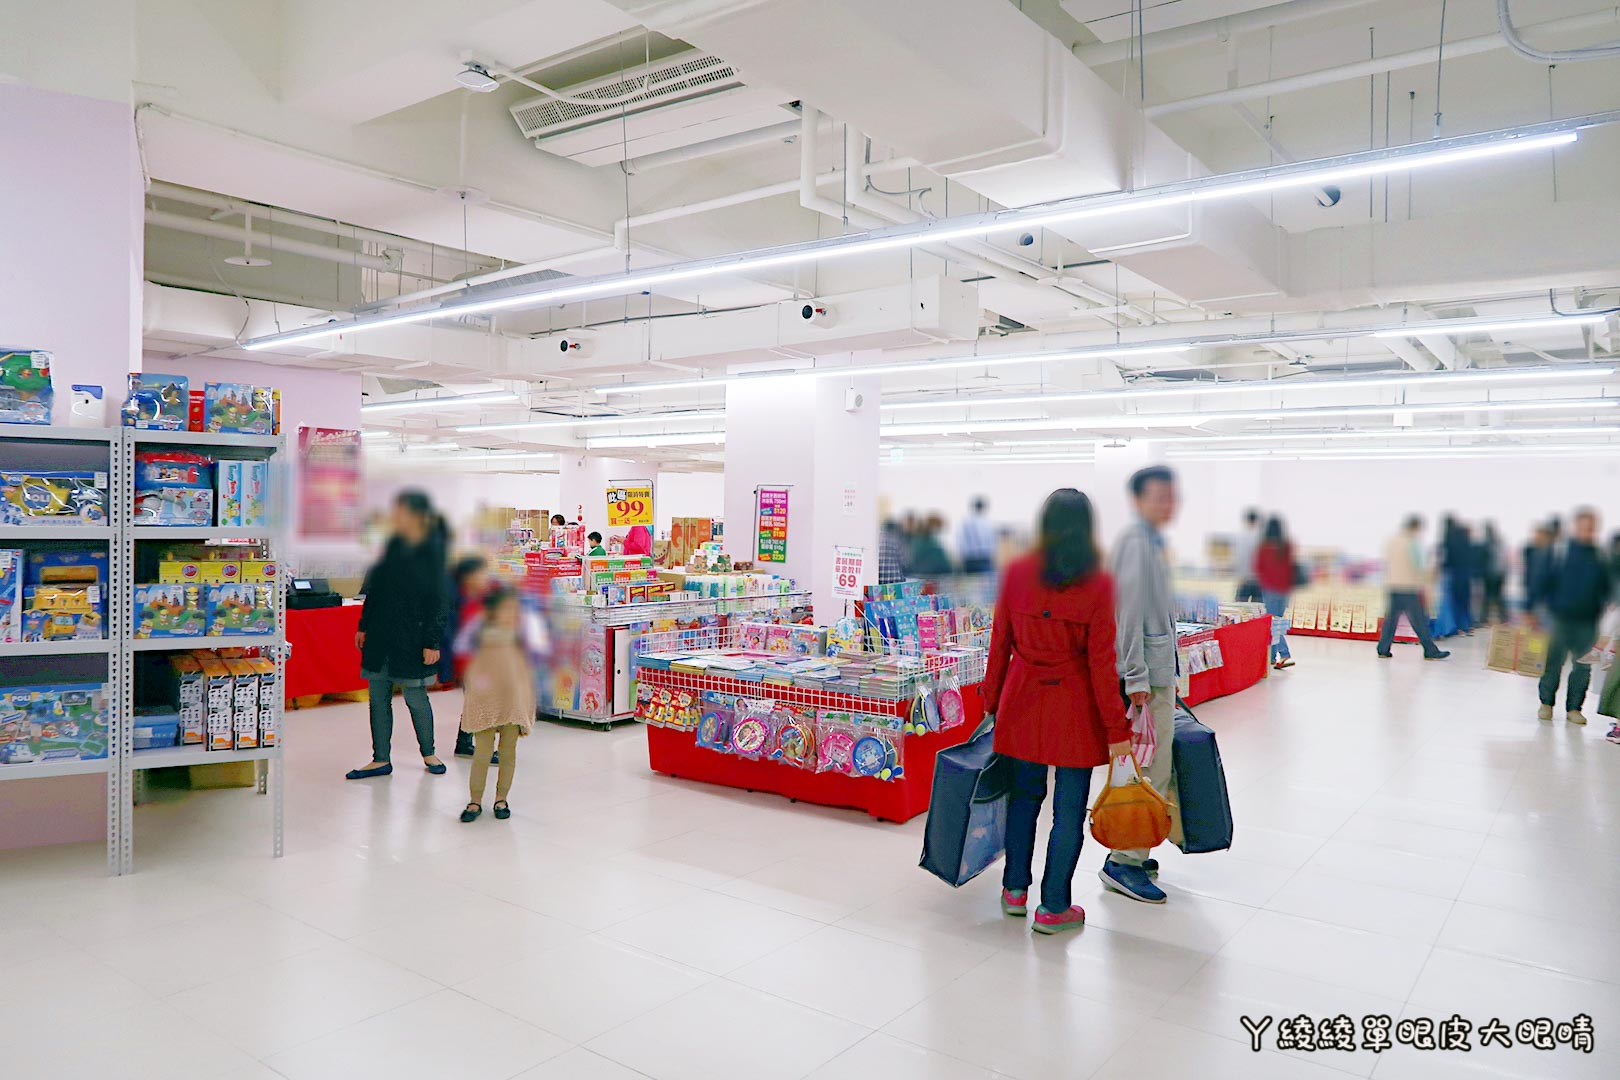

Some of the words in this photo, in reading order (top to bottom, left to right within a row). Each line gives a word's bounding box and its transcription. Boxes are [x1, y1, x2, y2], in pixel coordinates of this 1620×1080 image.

[616, 500, 644, 517] 99
[838, 573, 857, 588] 69
[12, 695, 31, 703] POLI
